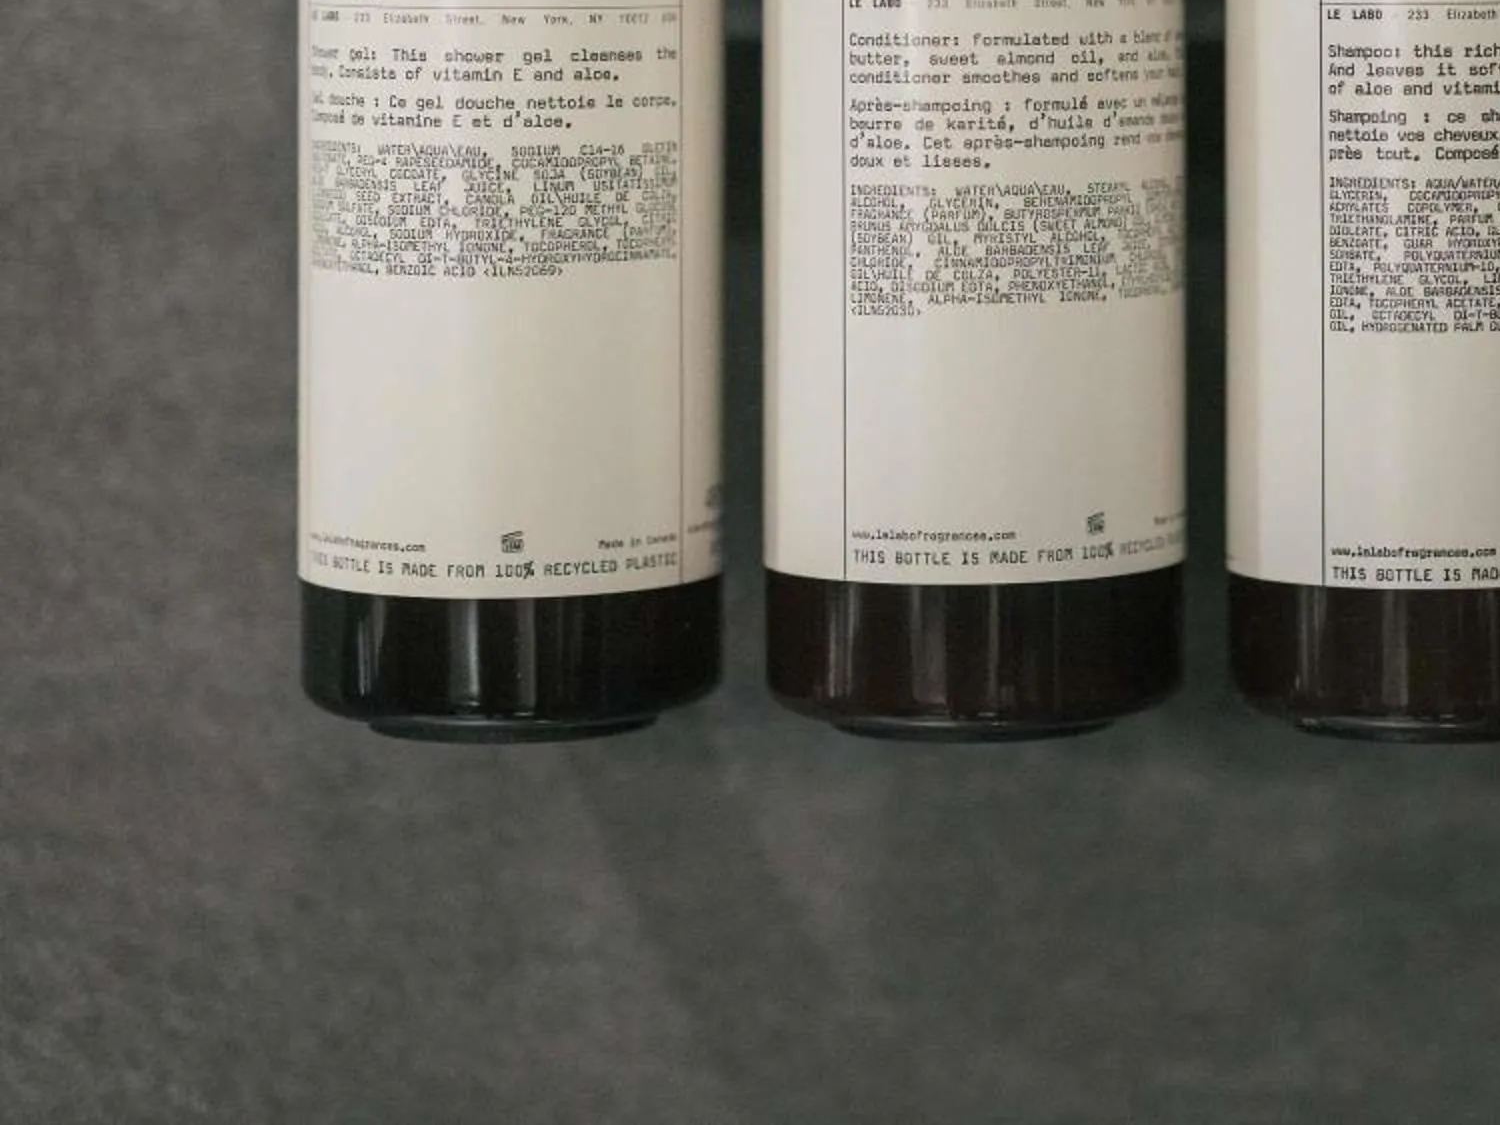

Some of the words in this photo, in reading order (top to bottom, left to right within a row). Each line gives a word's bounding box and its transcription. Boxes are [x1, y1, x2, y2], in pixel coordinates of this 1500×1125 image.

[1327, 8, 1341, 20] LE
[1352, 8, 1383, 20] LABO
[849, 32, 960, 47] Conditioner:
[973, 32, 1070, 47] formulated
[1079, 31, 1113, 46] with
[392, 48, 427, 62] This
[444, 48, 505, 63] shower
[523, 48, 552, 64] gel
[656, 47, 677, 60] the
[928, 53, 979, 67] sweet
[996, 51, 1056, 65] almond
[1117, 50, 1139, 62] and
[1327, 43, 1401, 60] Shampoo:
[1413, 43, 1453, 58] this
[433, 67, 504, 81] vitamin
[533, 68, 564, 82] and
[849, 70, 950, 85] conditioner
[962, 70, 1041, 84] smoothes
[1051, 70, 1079, 84] and
[1087, 68, 1139, 83] softens
[1327, 61, 1356, 77] And
[1365, 62, 1425, 77] leaves
[1437, 62, 1457, 77] it
[1328, 80, 1346, 96] of
[1354, 81, 1393, 96] aloe
[1403, 81, 1433, 96] and
[416, 96, 444, 111] gel
[455, 95, 515, 110] douche
[850, 97, 992, 115] Après-shampoing
[850, 116, 903, 131] beurre
[915, 118, 935, 132] de
[1328, 108, 1407, 125] Shampoing
[923, 135, 952, 150] Cet
[963, 133, 1105, 152] après-shampoing
[1113, 133, 1141, 146] rend
[1328, 128, 1389, 143] nettoie
[850, 154, 884, 168] doux
[1434, 145, 1500, 163] Composé
[853, 548, 885, 564] THIS
[895, 550, 951, 566] BOTTLE
[961, 551, 980, 566] IS
[989, 550, 1029, 565] MADE
[1037, 547, 1073, 564] FROM
[378, 560, 393, 574] IS
[402, 563, 437, 578] MADE
[447, 564, 486, 578] FROM
[496, 560, 535, 580] 100%
[543, 559, 618, 577] RECYCLED
[1332, 565, 1367, 581] THIS
[1375, 567, 1433, 583] BOTTLE
[1443, 567, 1462, 583] IS
